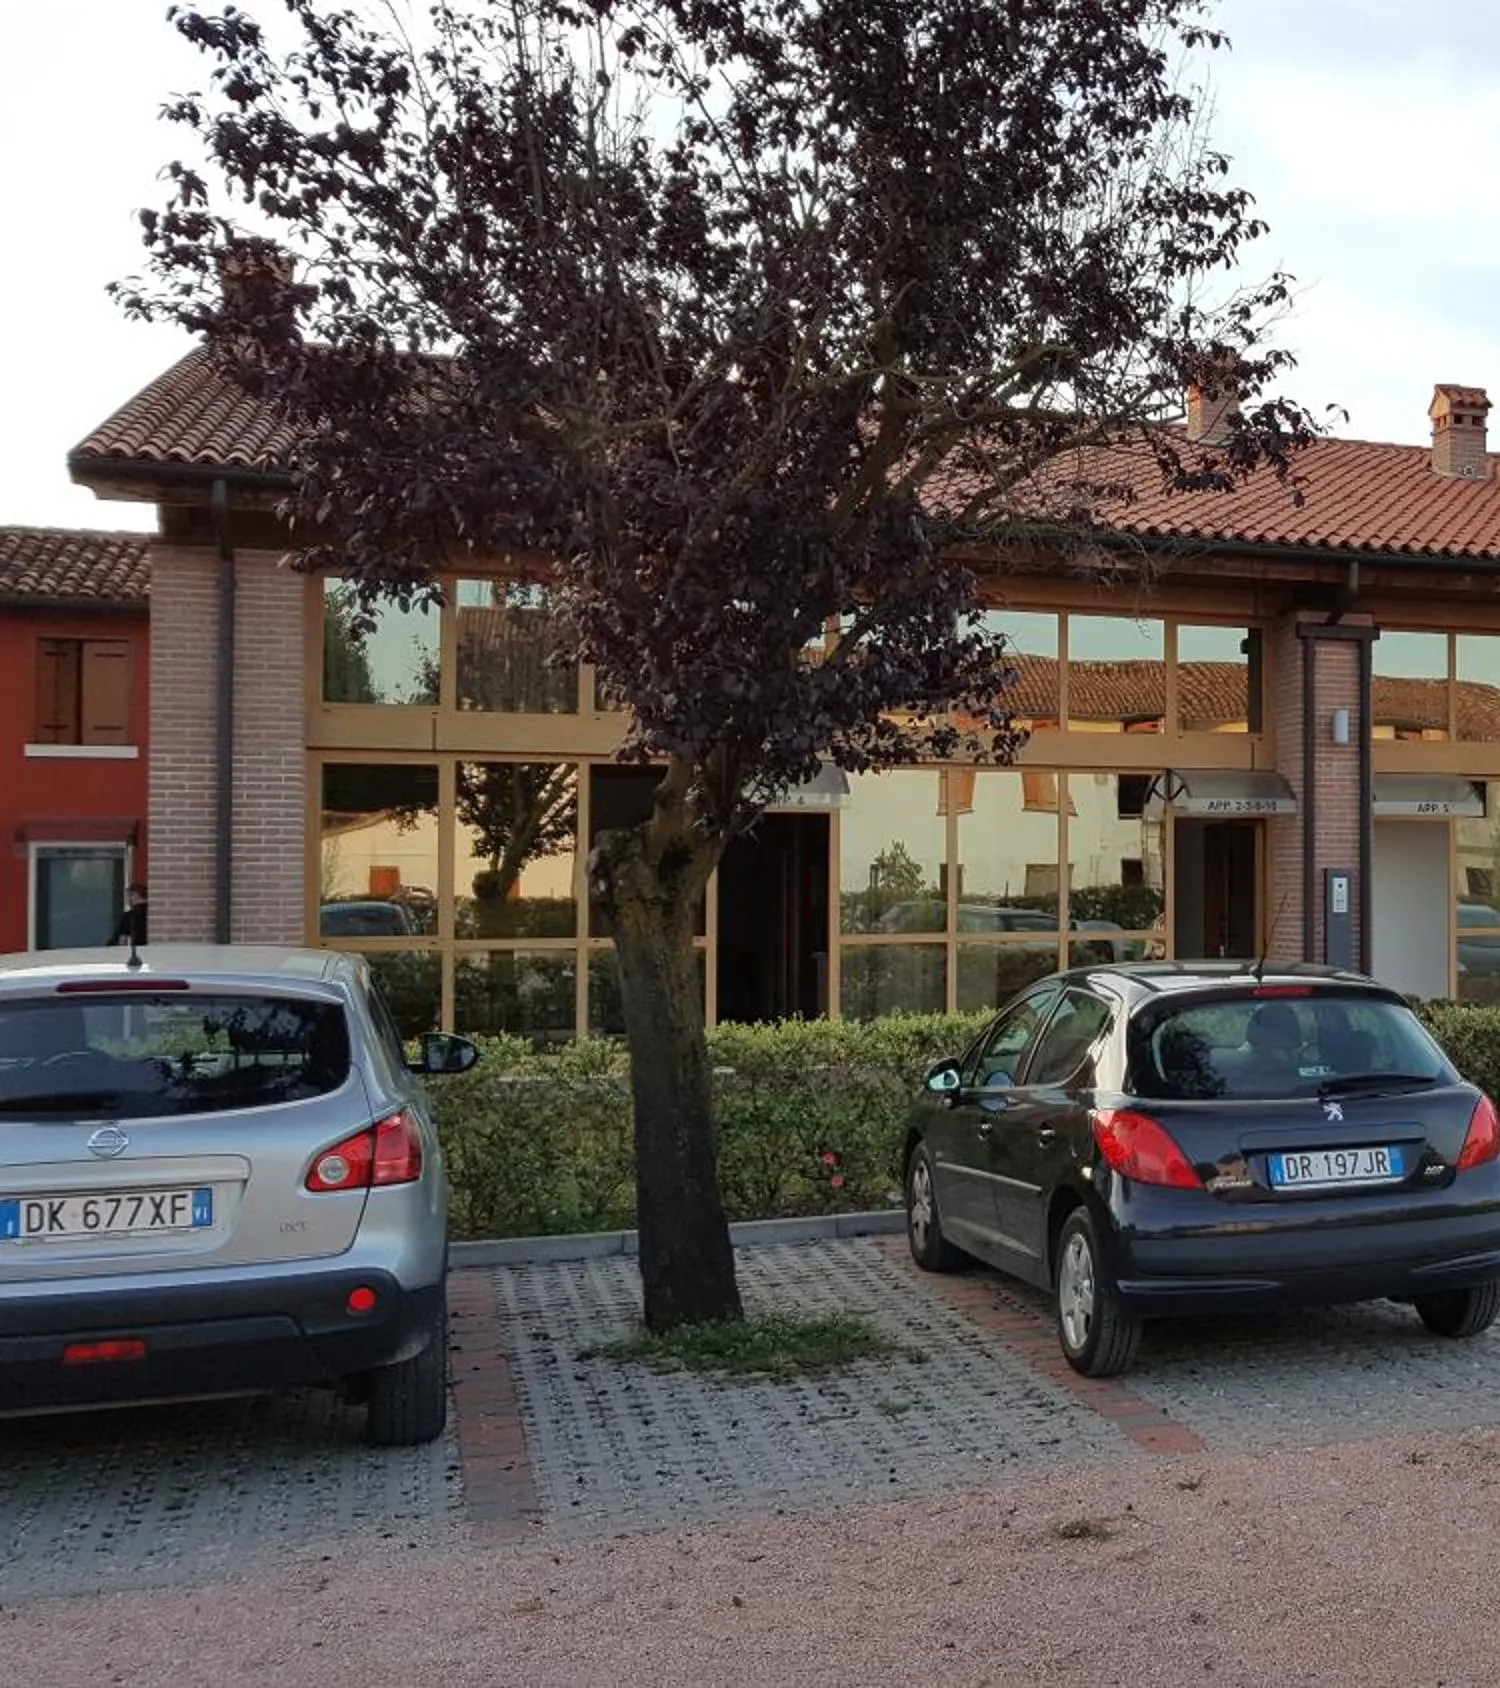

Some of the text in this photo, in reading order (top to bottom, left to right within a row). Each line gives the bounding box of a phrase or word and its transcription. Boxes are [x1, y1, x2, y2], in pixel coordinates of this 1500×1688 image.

[1285, 1156, 1312, 1181] DR
[25, 1201, 65, 1234] DK
[82, 1193, 189, 1230] 677XF
